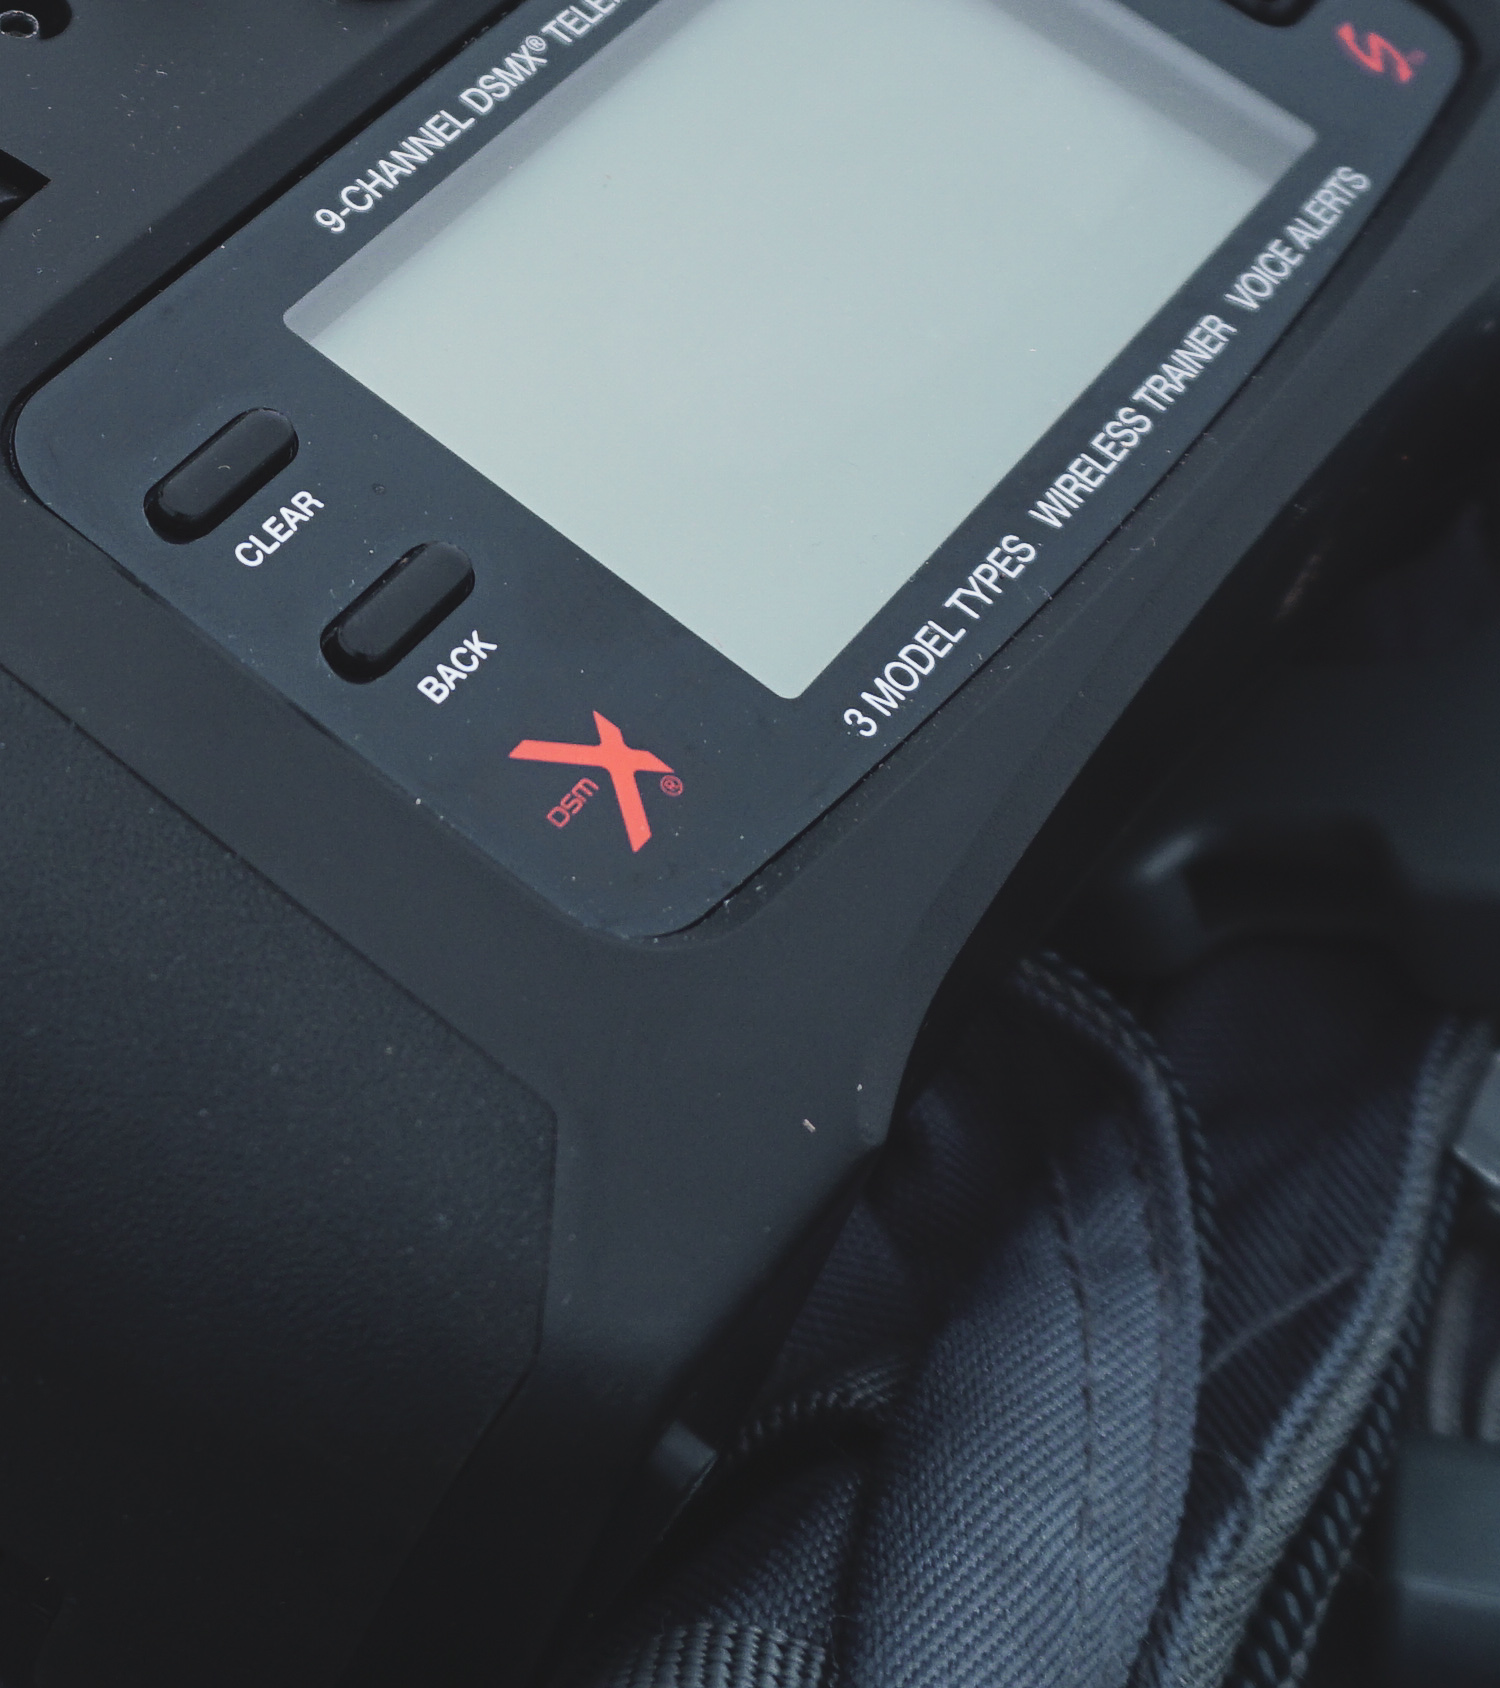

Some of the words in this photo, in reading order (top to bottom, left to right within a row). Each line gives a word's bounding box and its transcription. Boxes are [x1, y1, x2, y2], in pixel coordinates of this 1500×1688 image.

[314, 109, 476, 233] 9-CHANNEL
[1286, 165, 1371, 250] ALERTS
[1224, 238, 1304, 311] VOICE
[1131, 313, 1238, 412] TRAINER
[1028, 406, 1153, 529] WIRELESS
[234, 490, 325, 568] CLEAR
[943, 534, 1037, 620] TYPES
[416, 629, 498, 705] BACK
[860, 620, 967, 717] MODEL
[843, 708, 878, 737] 3
